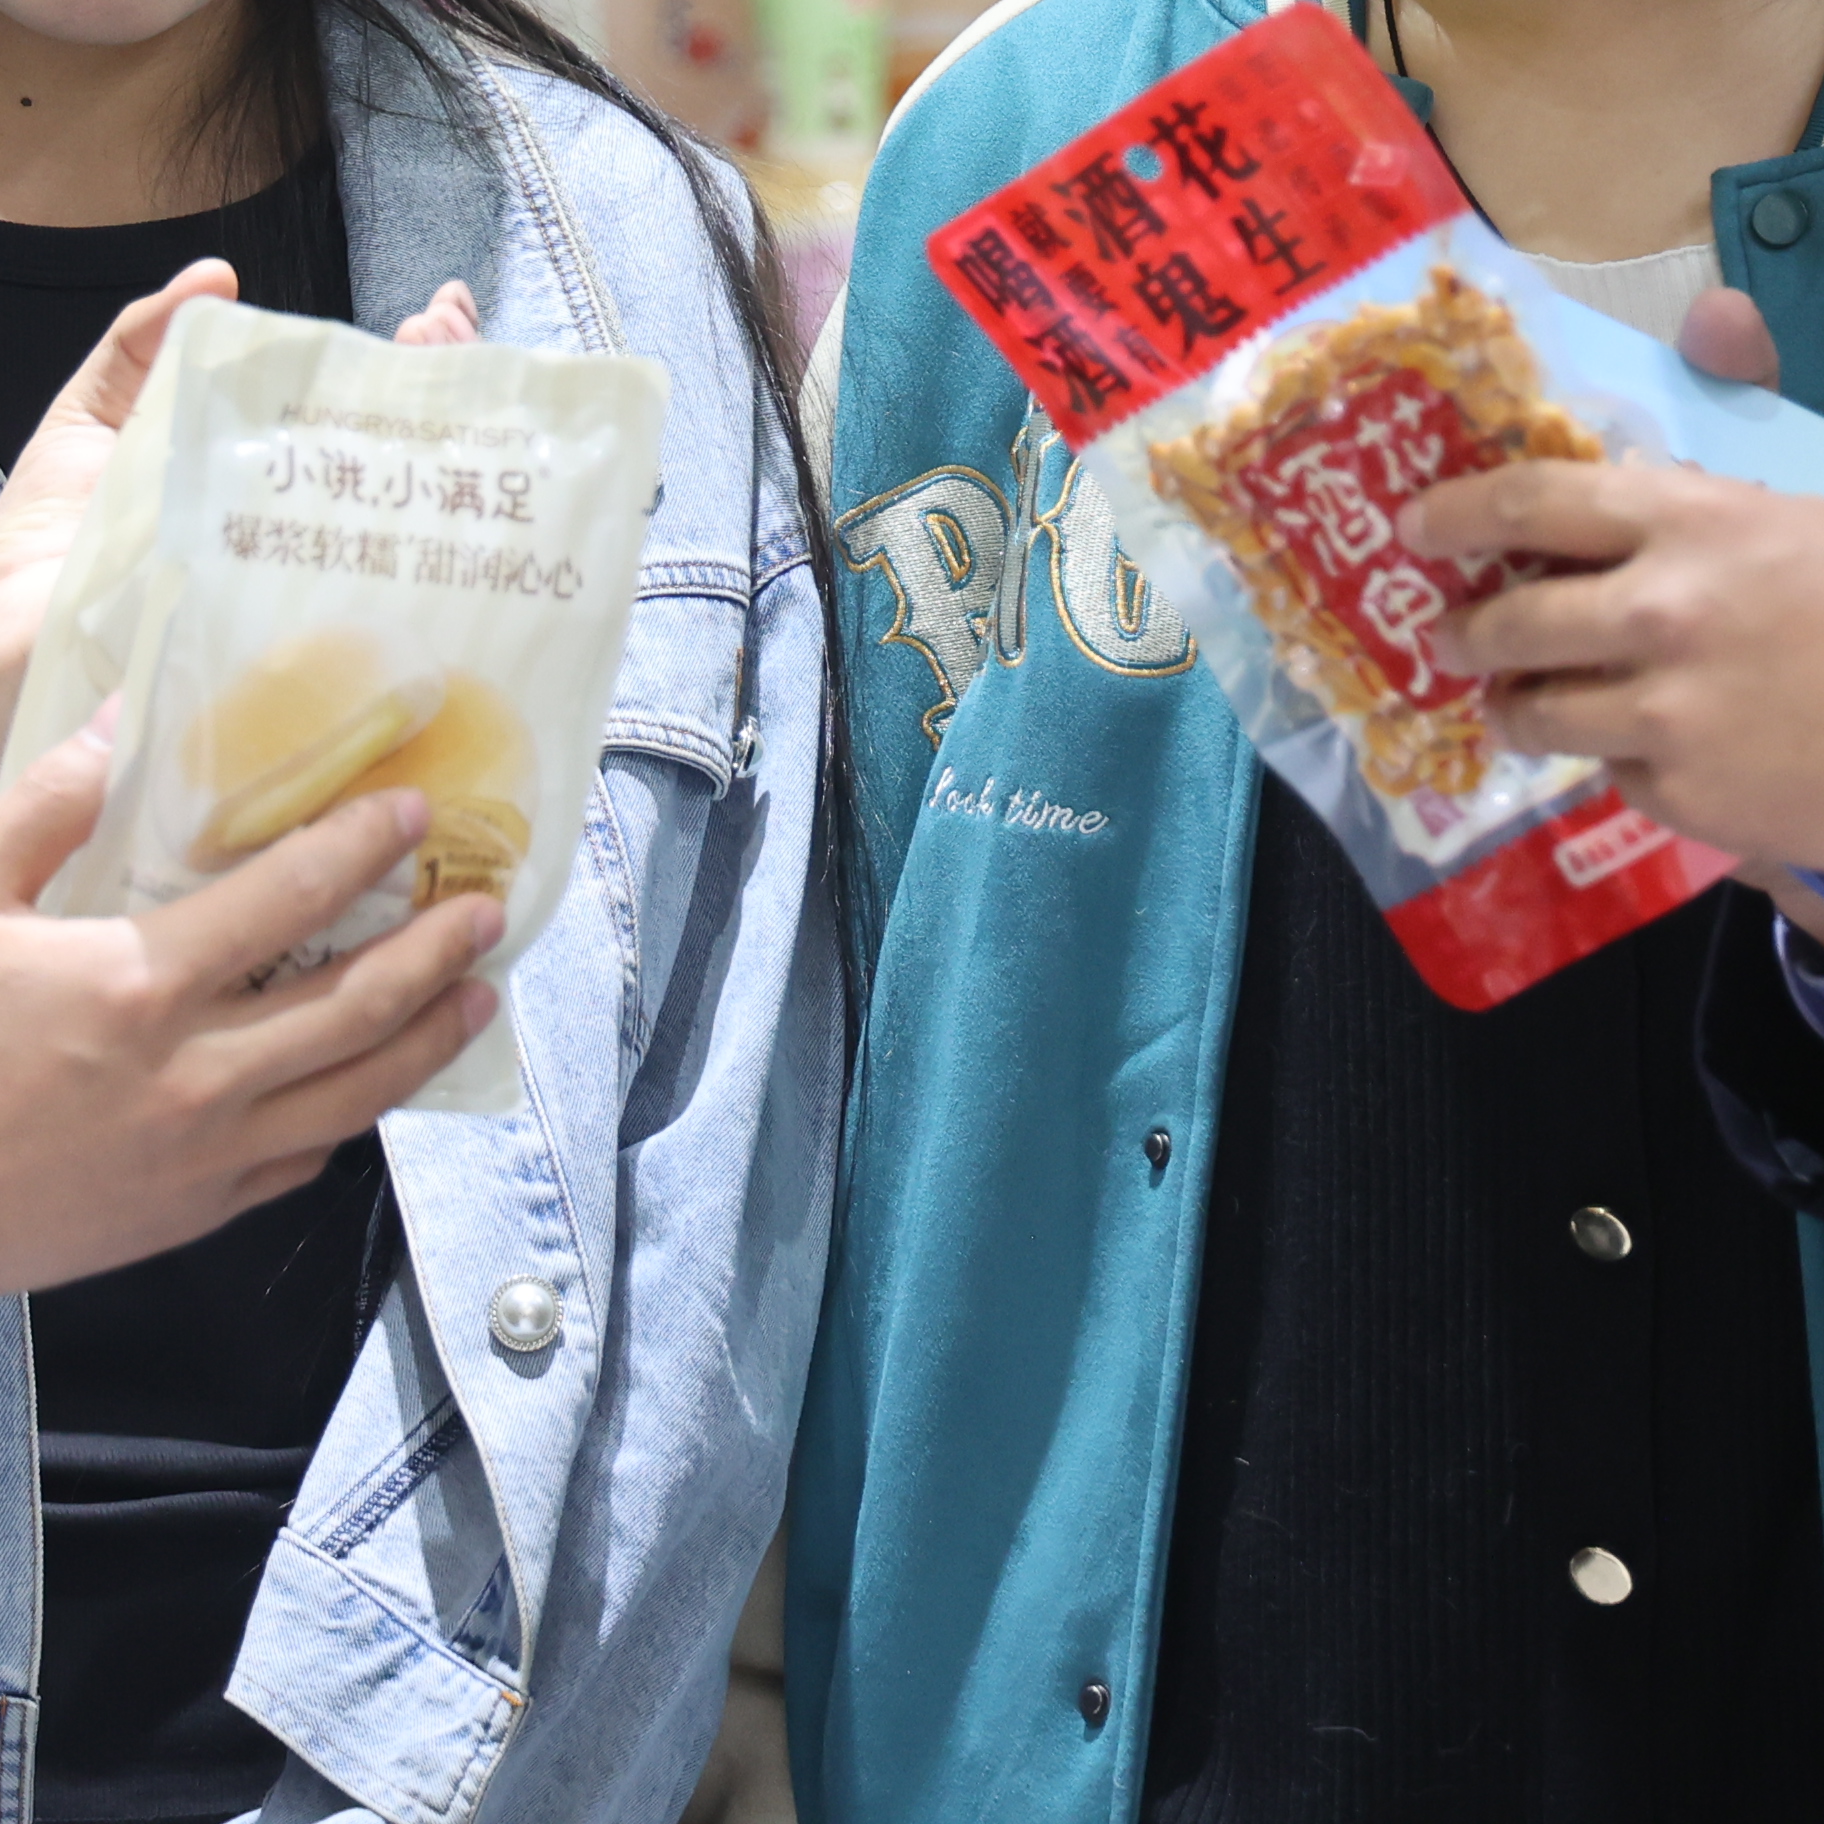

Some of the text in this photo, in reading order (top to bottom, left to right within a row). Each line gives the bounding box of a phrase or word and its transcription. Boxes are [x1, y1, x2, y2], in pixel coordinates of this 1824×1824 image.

[1050, 148, 1248, 361] 酒鬼
[1150, 98, 1330, 298] 花生
[954, 223, 1135, 415] 喝酒
[1005, 786, 1111, 836] time
